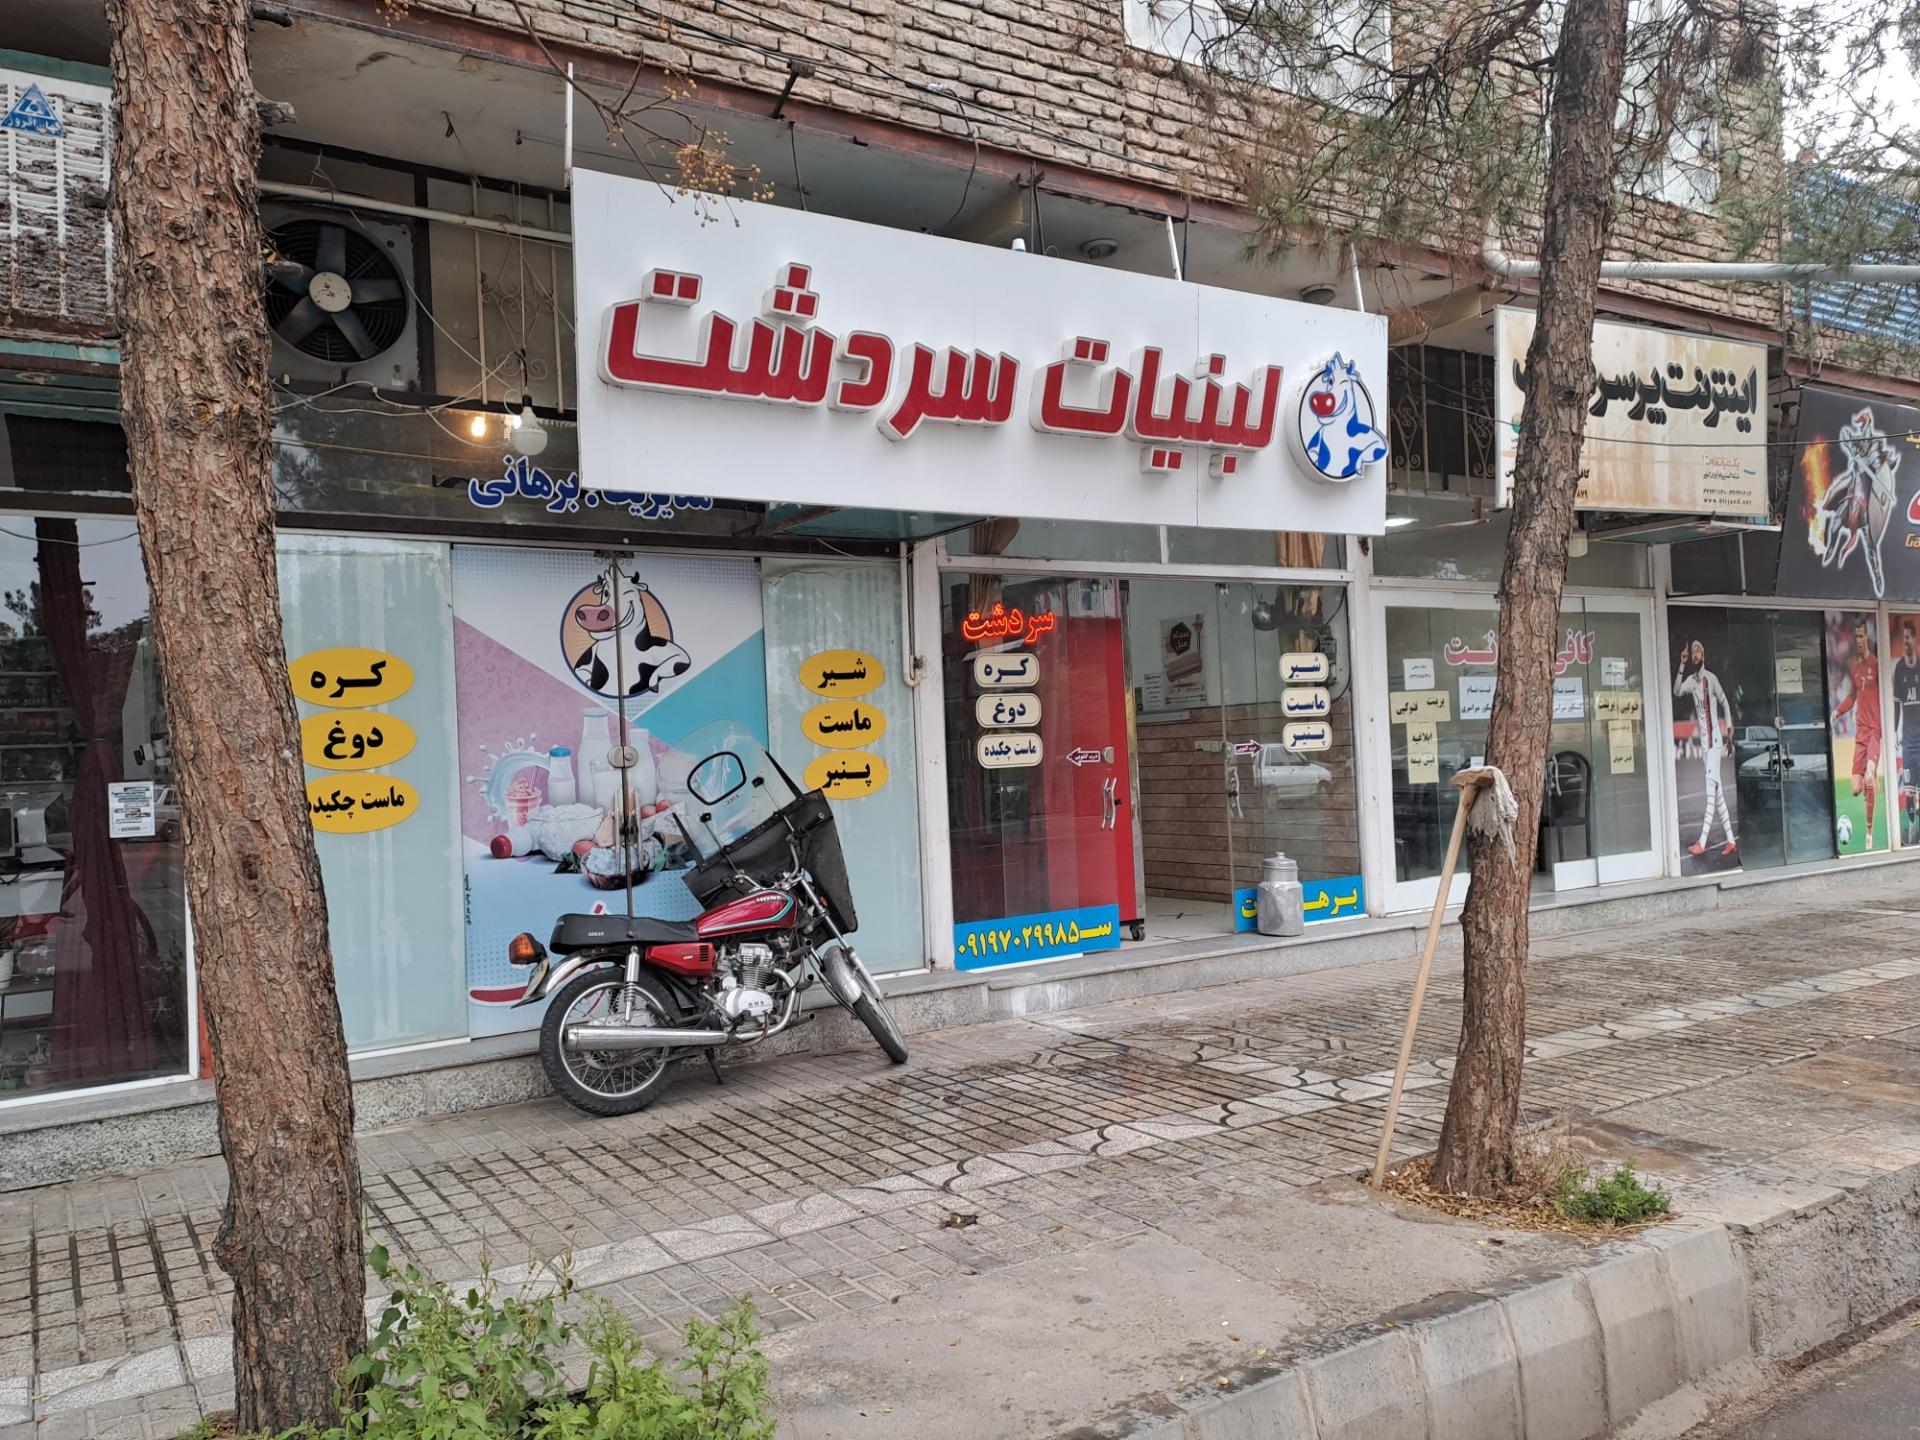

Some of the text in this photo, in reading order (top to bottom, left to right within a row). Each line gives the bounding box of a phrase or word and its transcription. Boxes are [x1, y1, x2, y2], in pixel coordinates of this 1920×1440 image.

[596, 259, 1285, 480] لبنیات سردشت
[1661, 361, 1757, 433] اینترنت
[468, 455, 580, 512] برهانی
[311, 661, 387, 698] کره
[817, 657, 867, 689] شیر
[984, 657, 1029, 683] کره
[1288, 656, 1321, 678] شیر
[992, 697, 1026, 723] دوغ
[1286, 694, 1325, 712] ماست
[819, 708, 872, 734] ماست
[323, 720, 384, 760] دوغ
[1290, 726, 1325, 747] پنیر
[984, 739, 1037, 761] ماست چکیده
[822, 761, 872, 788] پنیر
[361, 785, 405, 811] ماست
